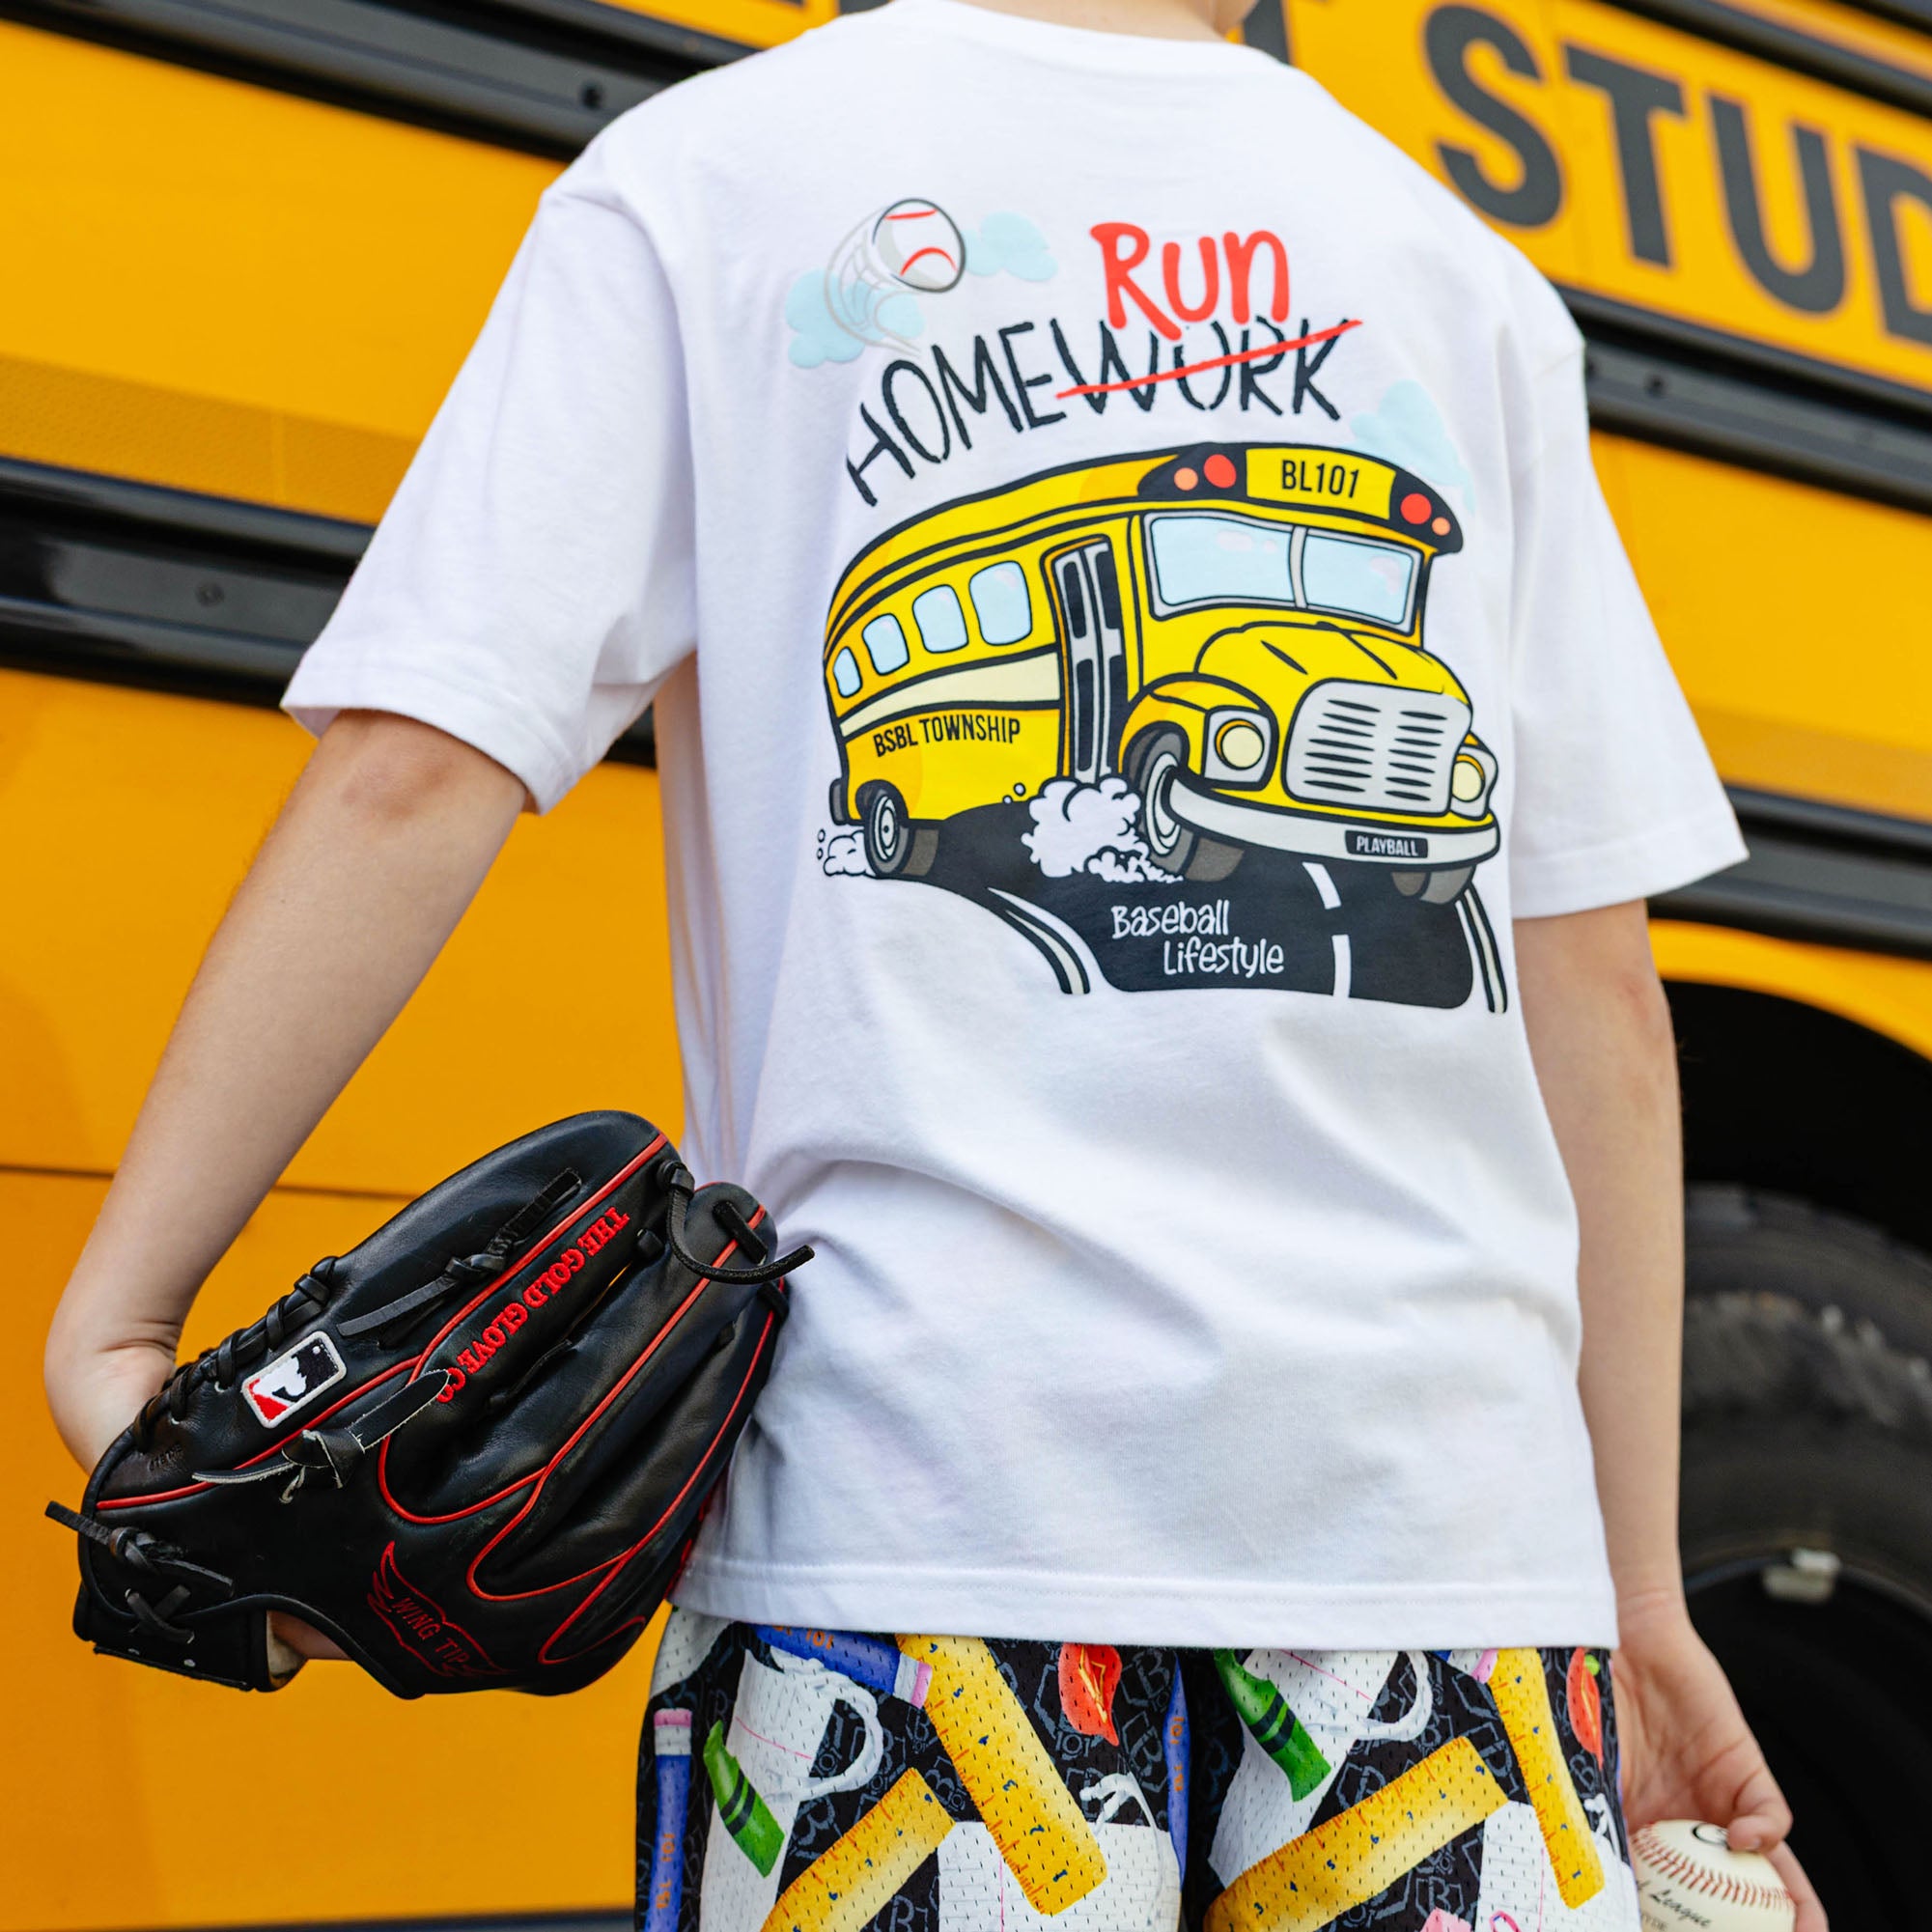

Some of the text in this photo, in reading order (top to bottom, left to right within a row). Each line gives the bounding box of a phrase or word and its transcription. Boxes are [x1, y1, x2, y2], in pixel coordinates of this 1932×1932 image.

[1422, 4, 1932, 350] STUD
[1090, 222, 1291, 340] Run
[846, 314, 1343, 507] HOMEWORK
[1281, 460, 1359, 498] BL101
[873, 714, 1021, 757] BSBL TOWNSHIP
[1357, 835, 1418, 856] PLAYBALL
[1110, 899, 1229, 938] Baseball
[1164, 936, 1284, 978] Lifestyle
[576, 1207, 630, 1257] THE
[522, 1248, 586, 1308] GOLD
[457, 1303, 529, 1375] GLOVE
[391, 1597, 471, 1664] WING TIP
[1648, 1889, 1712, 1927] League
